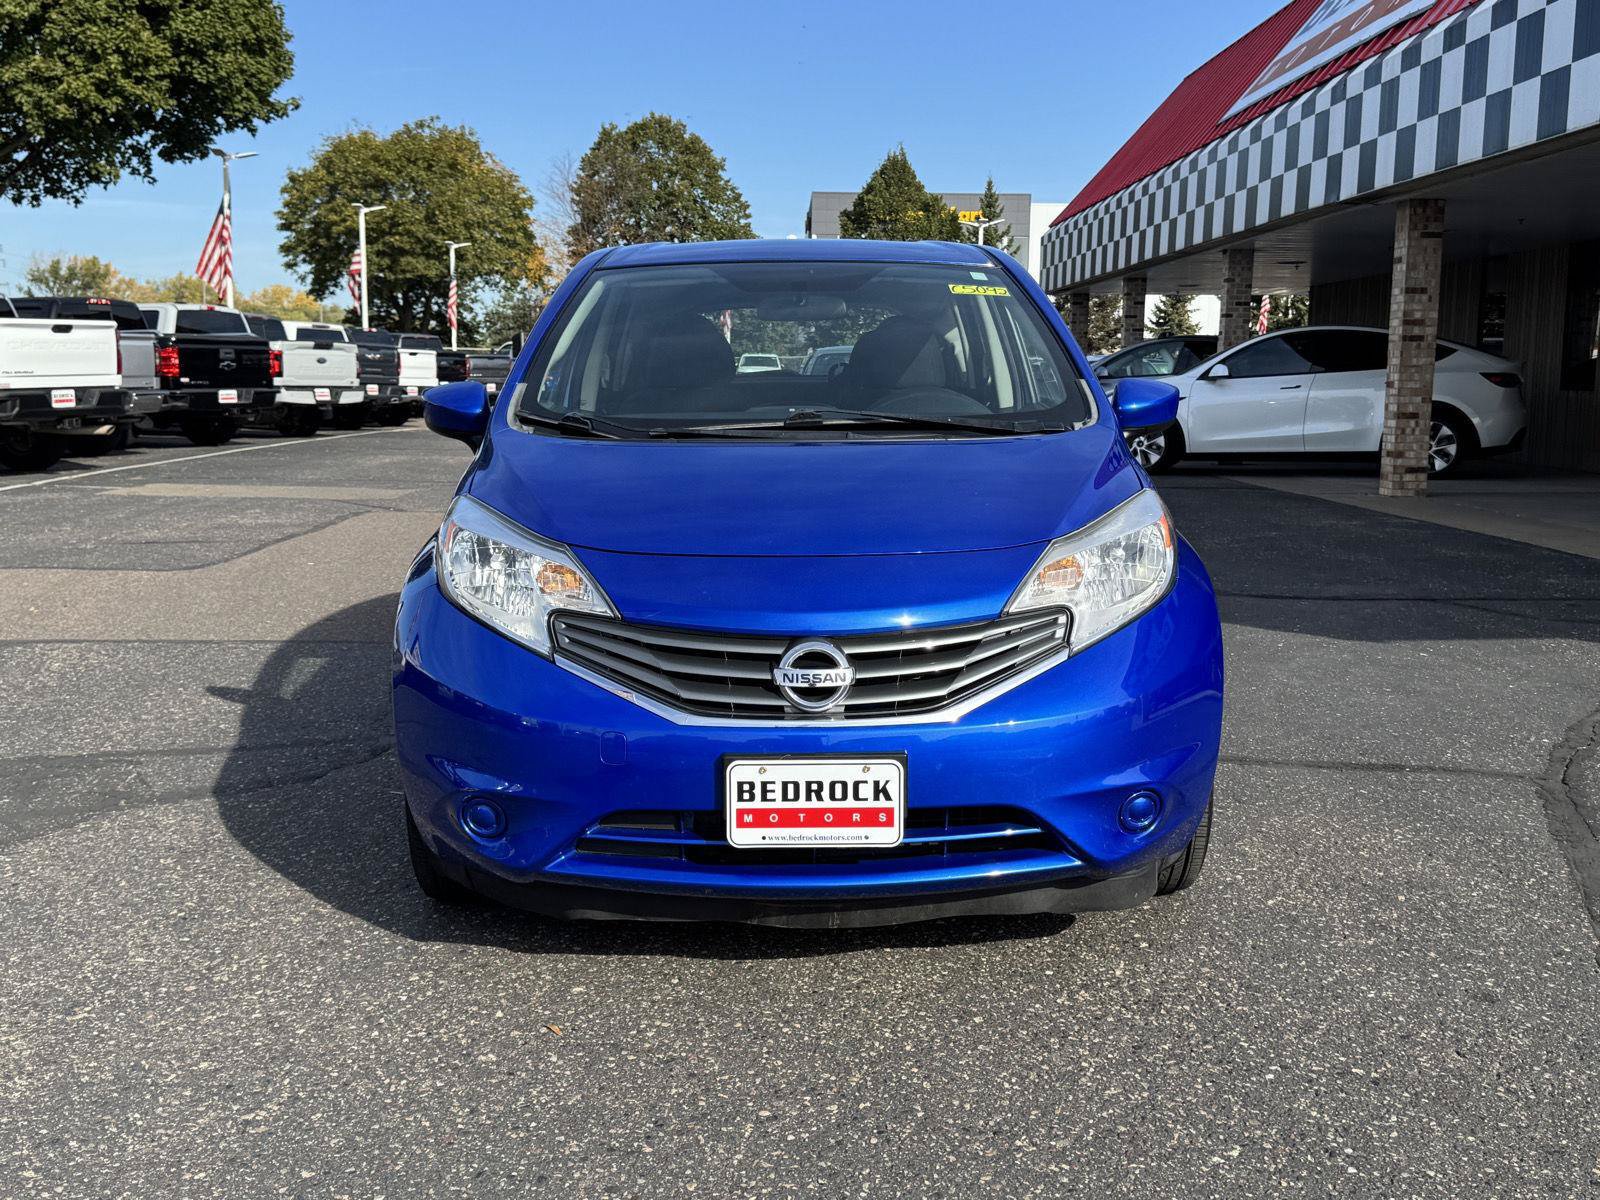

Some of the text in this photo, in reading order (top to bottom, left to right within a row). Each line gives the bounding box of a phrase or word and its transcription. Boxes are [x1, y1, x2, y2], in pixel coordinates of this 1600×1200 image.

[782, 673, 847, 684] NISSAN
[736, 780, 894, 802] BEDROCK
[743, 812, 888, 823] MOTORS
[768, 833, 863, 842] www.bedrockmotors.com
